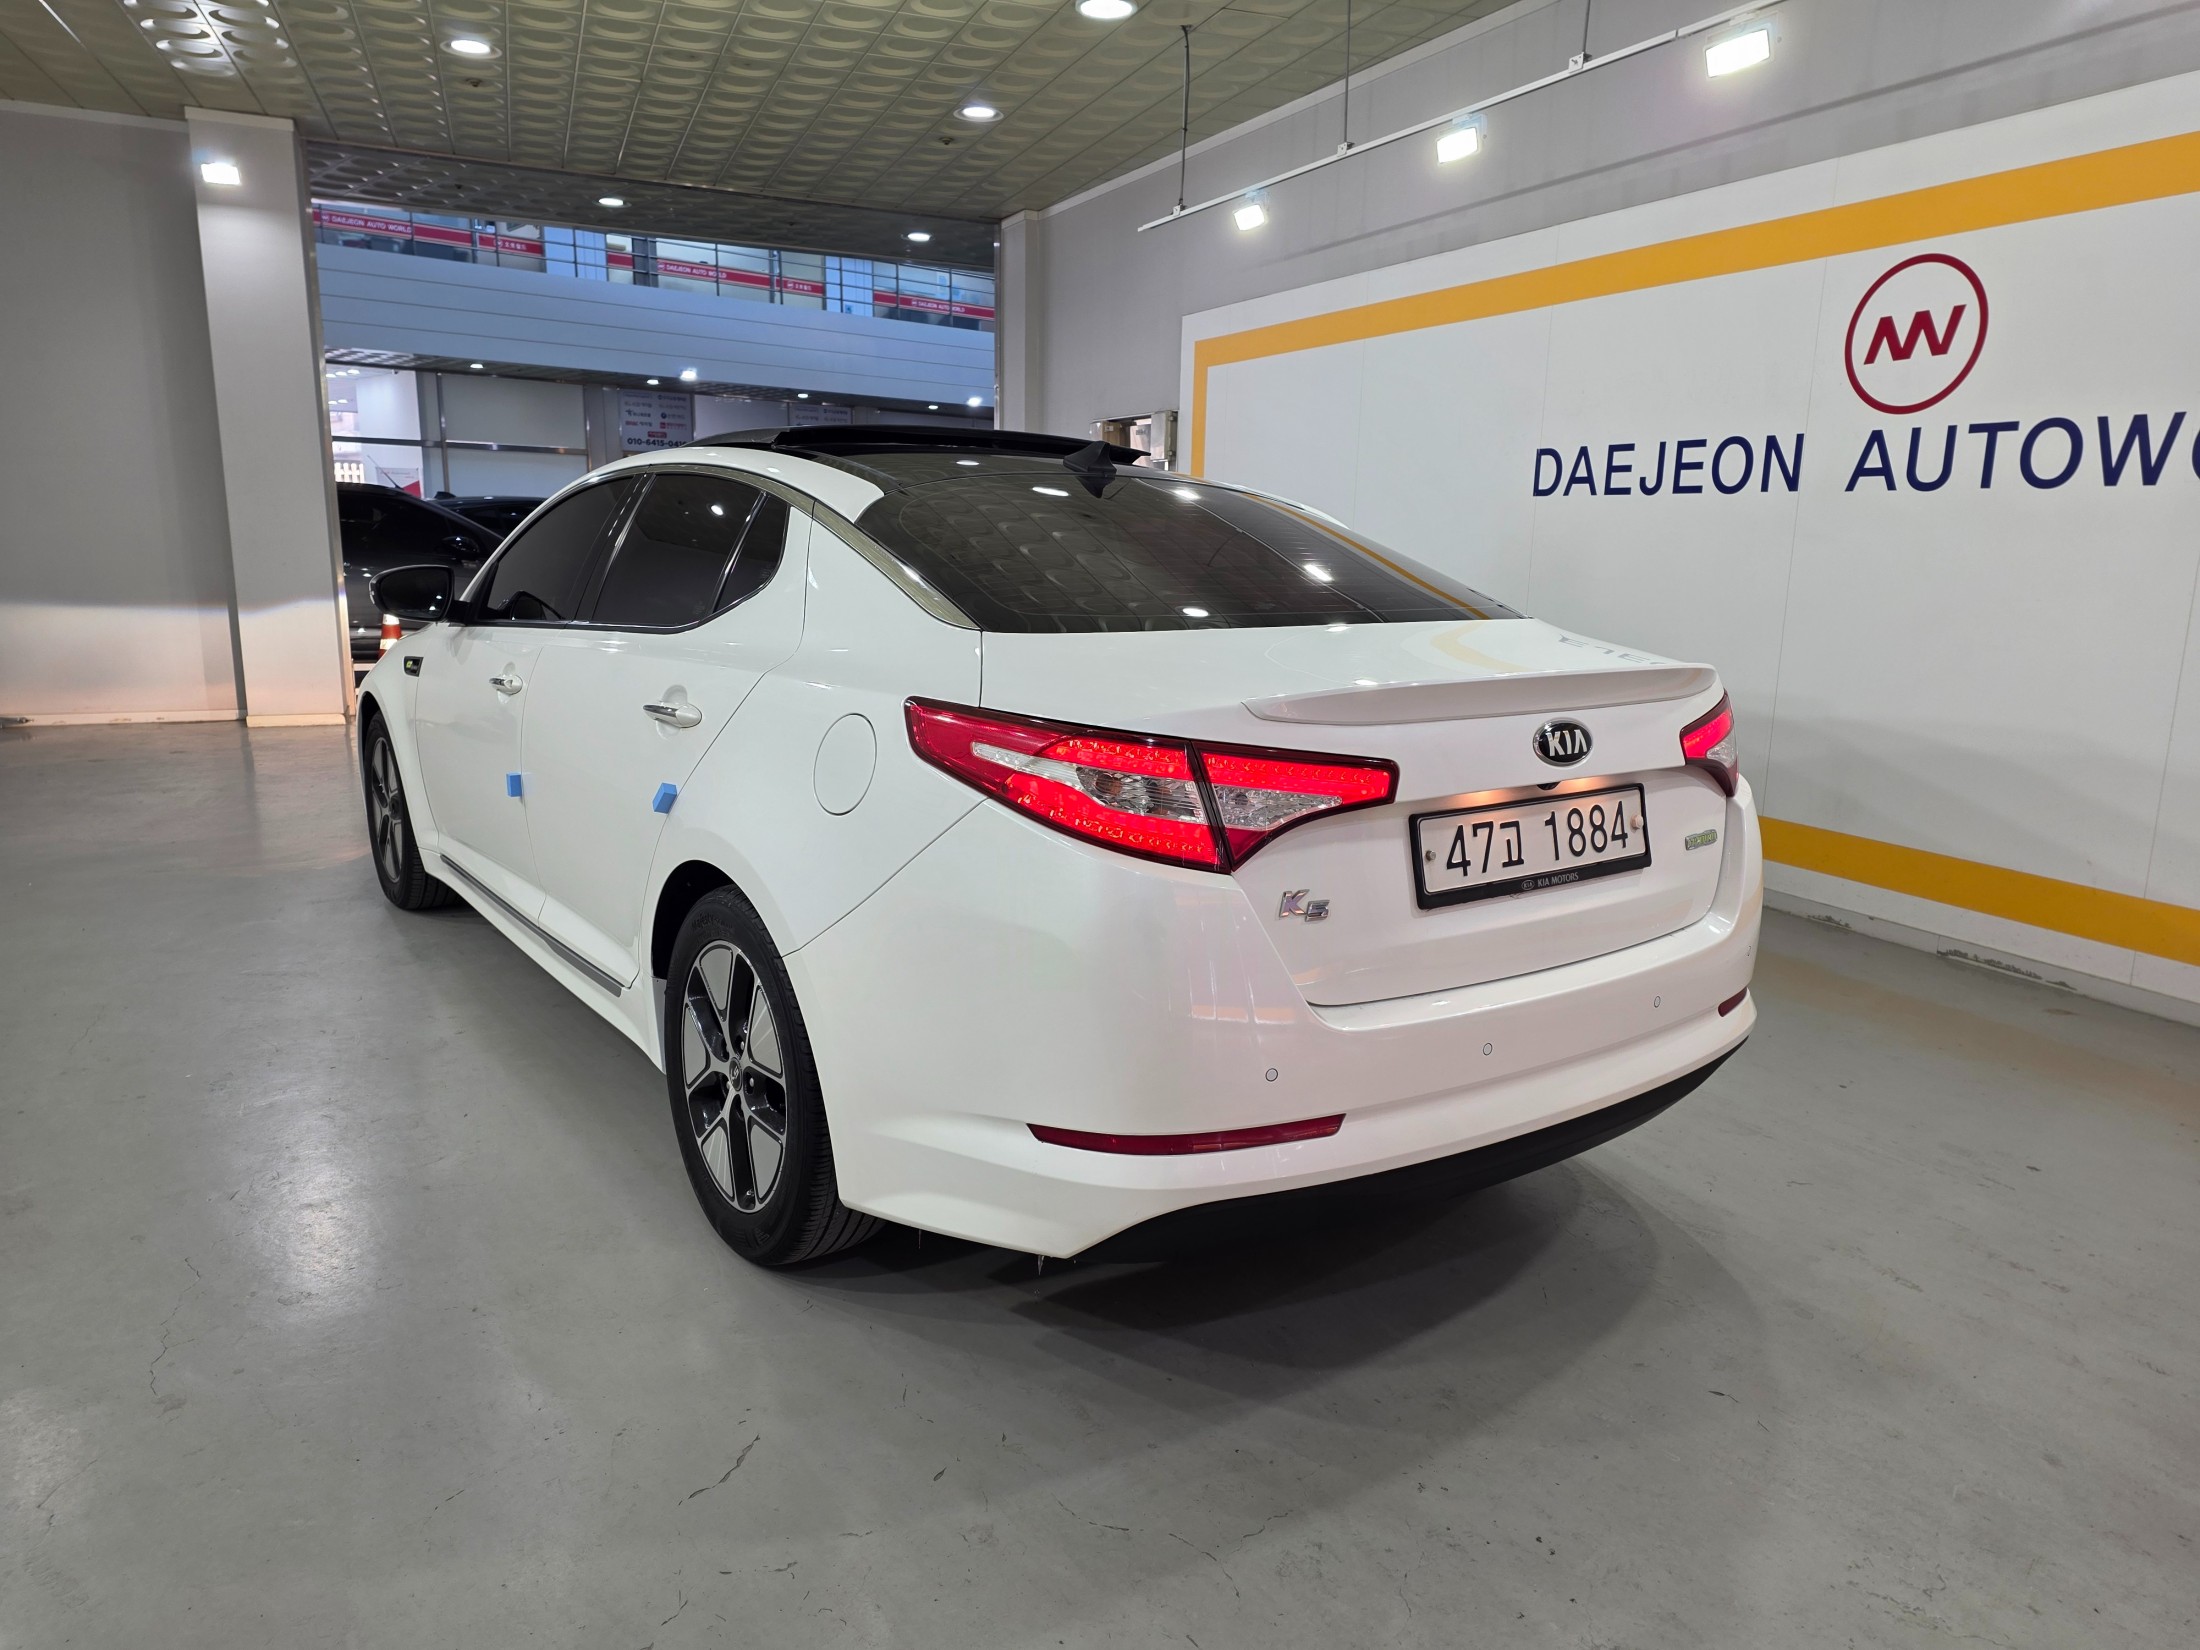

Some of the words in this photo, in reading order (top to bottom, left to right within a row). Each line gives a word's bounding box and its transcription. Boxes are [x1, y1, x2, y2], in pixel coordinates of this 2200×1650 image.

[366, 220, 386, 230] AUTO
[387, 224, 412, 233] WORLD
[1532, 432, 1804, 497] DAEJEON
[1845, 411, 2200, 493] AUTOW
[1546, 728, 1589, 757] KIA
[1446, 820, 1525, 877] 47고
[1544, 800, 1629, 861] 1884
[1537, 877, 1550, 888] KIA
[1551, 872, 1579, 885] MOTORS
[1278, 888, 1331, 923] K5
